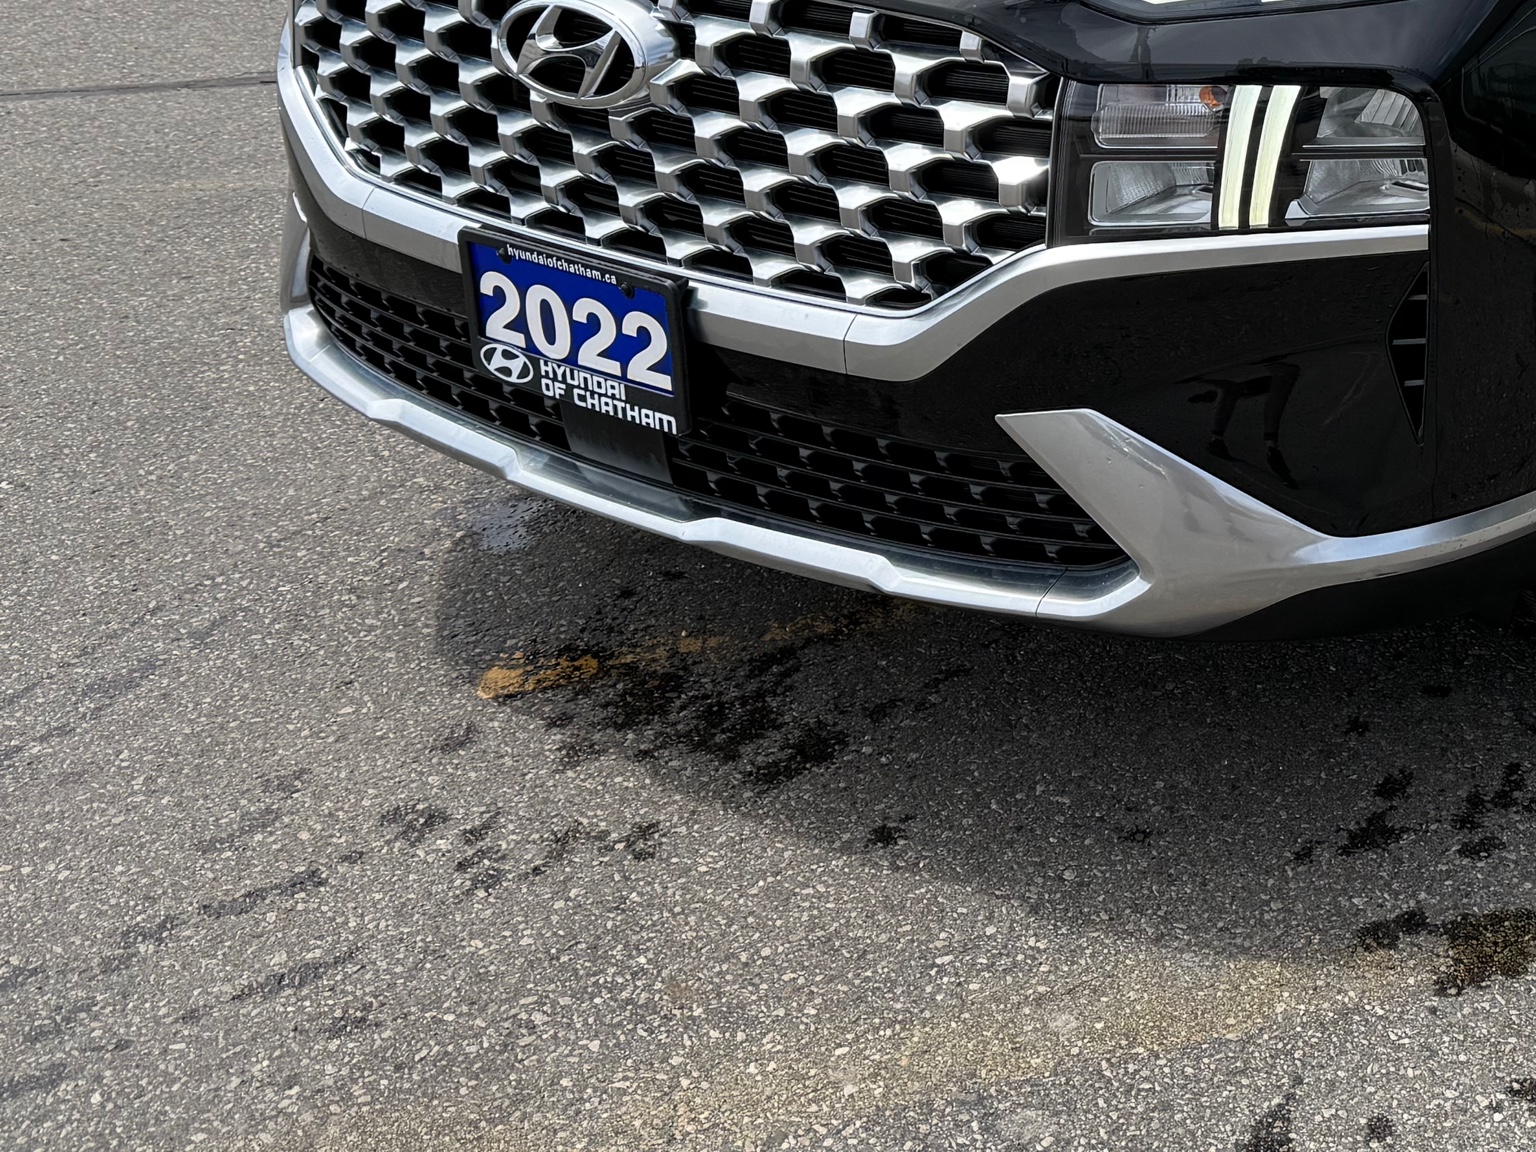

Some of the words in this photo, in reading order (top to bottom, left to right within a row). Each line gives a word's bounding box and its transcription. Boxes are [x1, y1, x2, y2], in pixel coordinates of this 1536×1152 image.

[506, 244, 617, 285] hyundaiofchatham.ca
[480, 270, 672, 391] 2022
[540, 359, 626, 400] HYUNDAI
[541, 378, 566, 399] OF
[573, 391, 677, 435] CHATHAM
